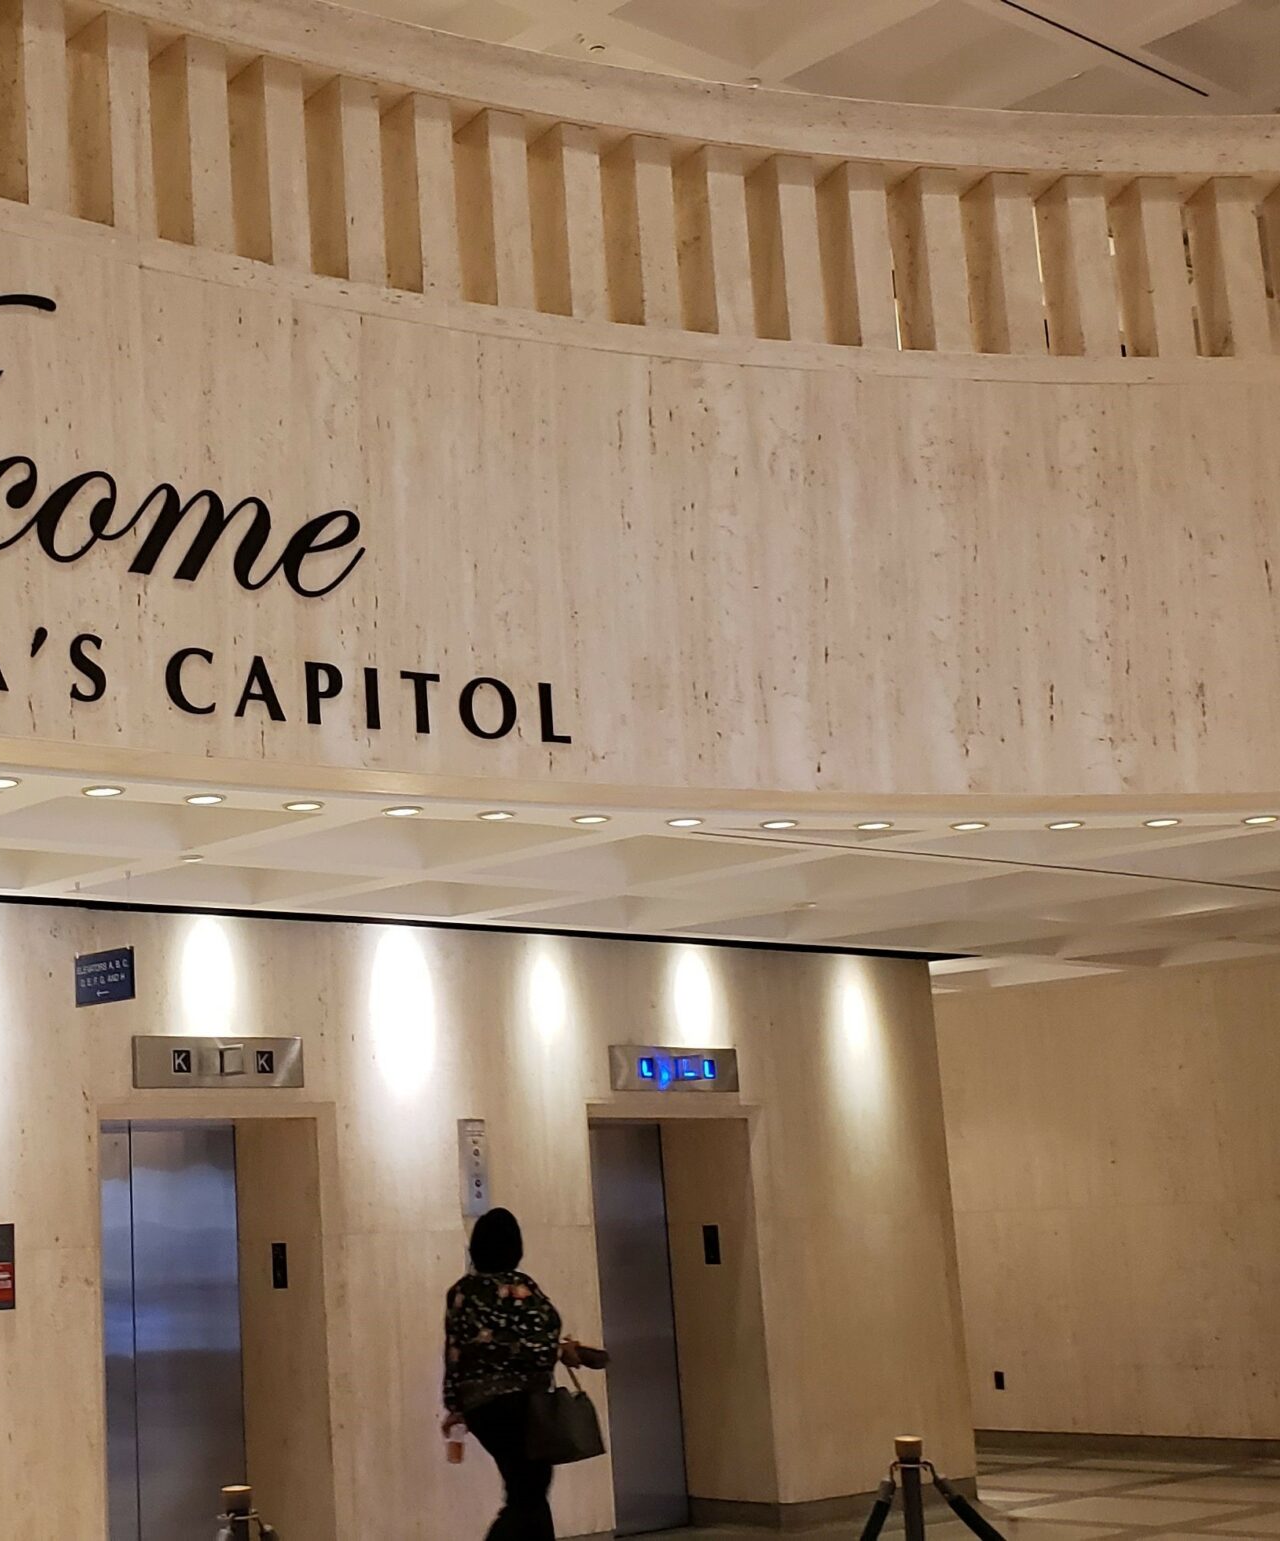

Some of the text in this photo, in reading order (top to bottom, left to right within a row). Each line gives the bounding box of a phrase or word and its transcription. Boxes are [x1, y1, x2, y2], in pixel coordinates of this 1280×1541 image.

[165, 647, 572, 745] CAPITOL
[175, 1053, 270, 1072] K K
[641, 1060, 653, 1077] L
[703, 1060, 714, 1077] L
